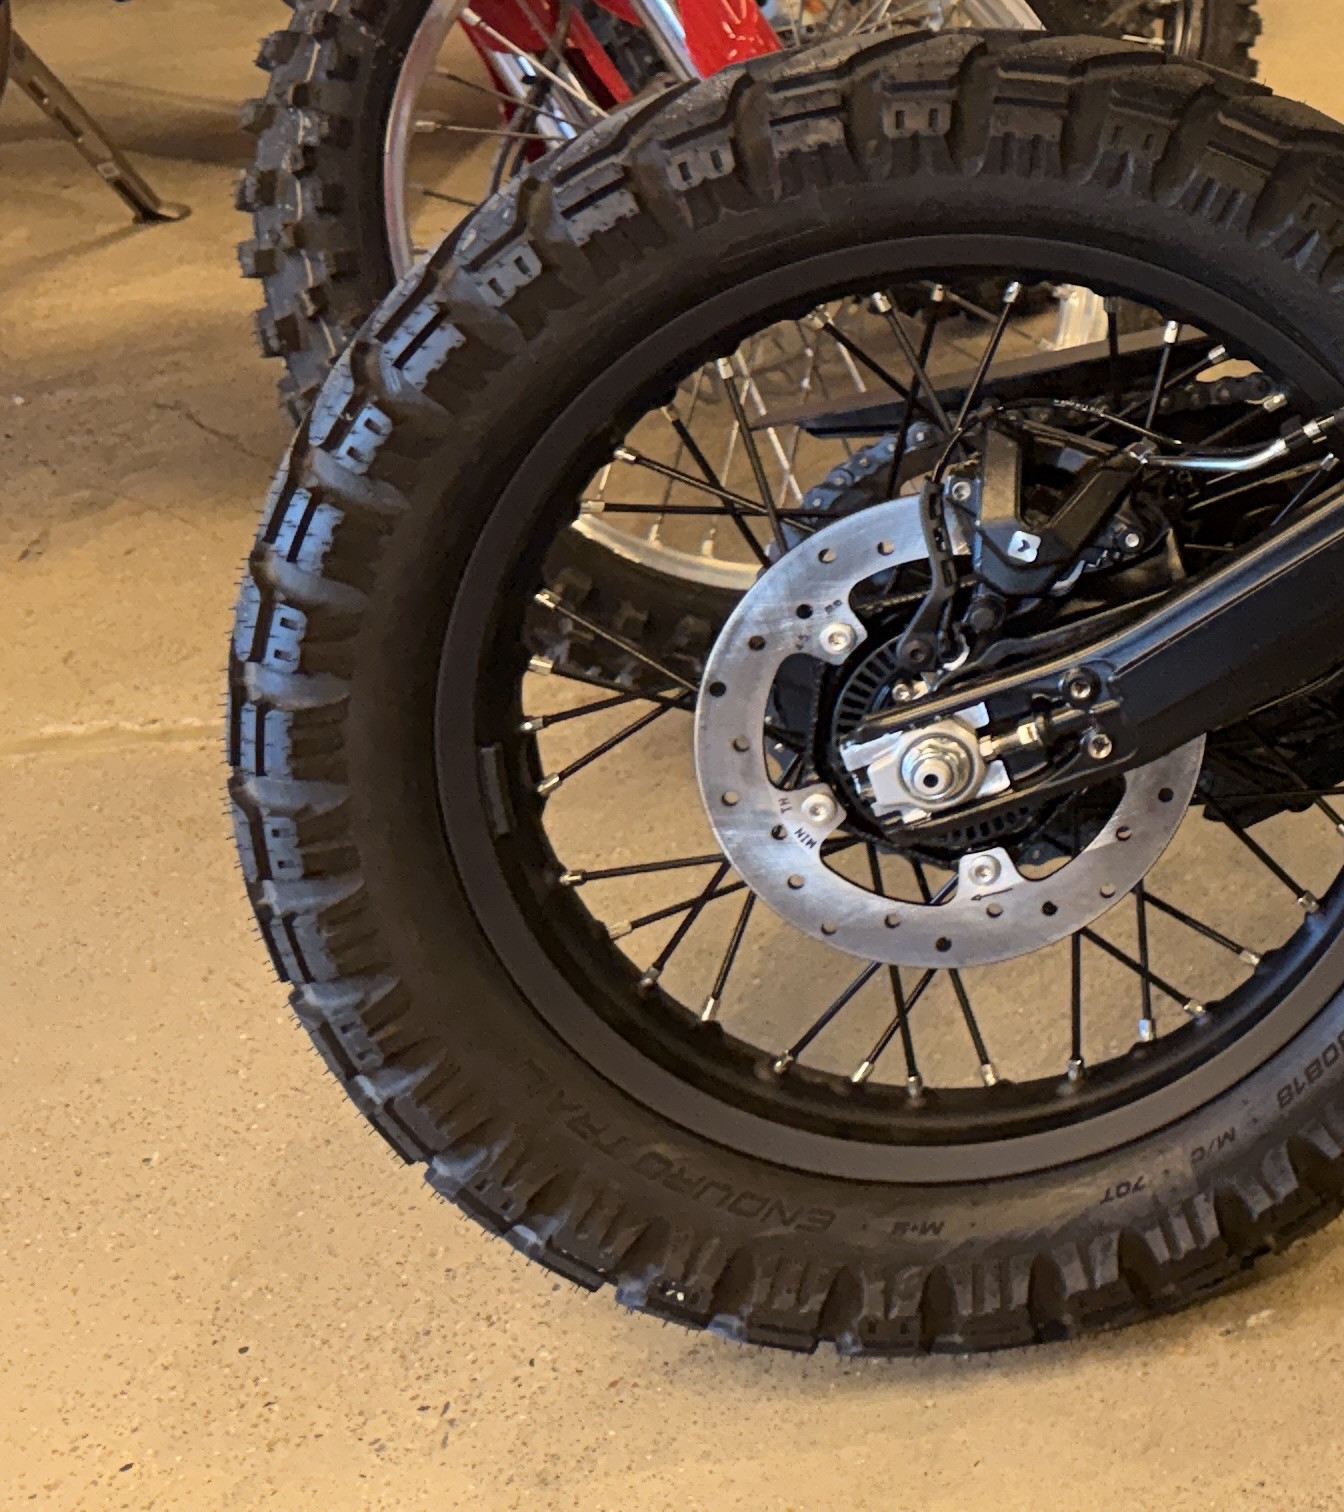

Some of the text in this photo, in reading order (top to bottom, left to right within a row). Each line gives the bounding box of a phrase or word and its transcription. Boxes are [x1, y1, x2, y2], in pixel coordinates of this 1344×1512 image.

[777, 797, 818, 851] MIN TH
[633, 1149, 838, 1235] ENDURO
[1099, 1174, 1148, 1205] 70T
